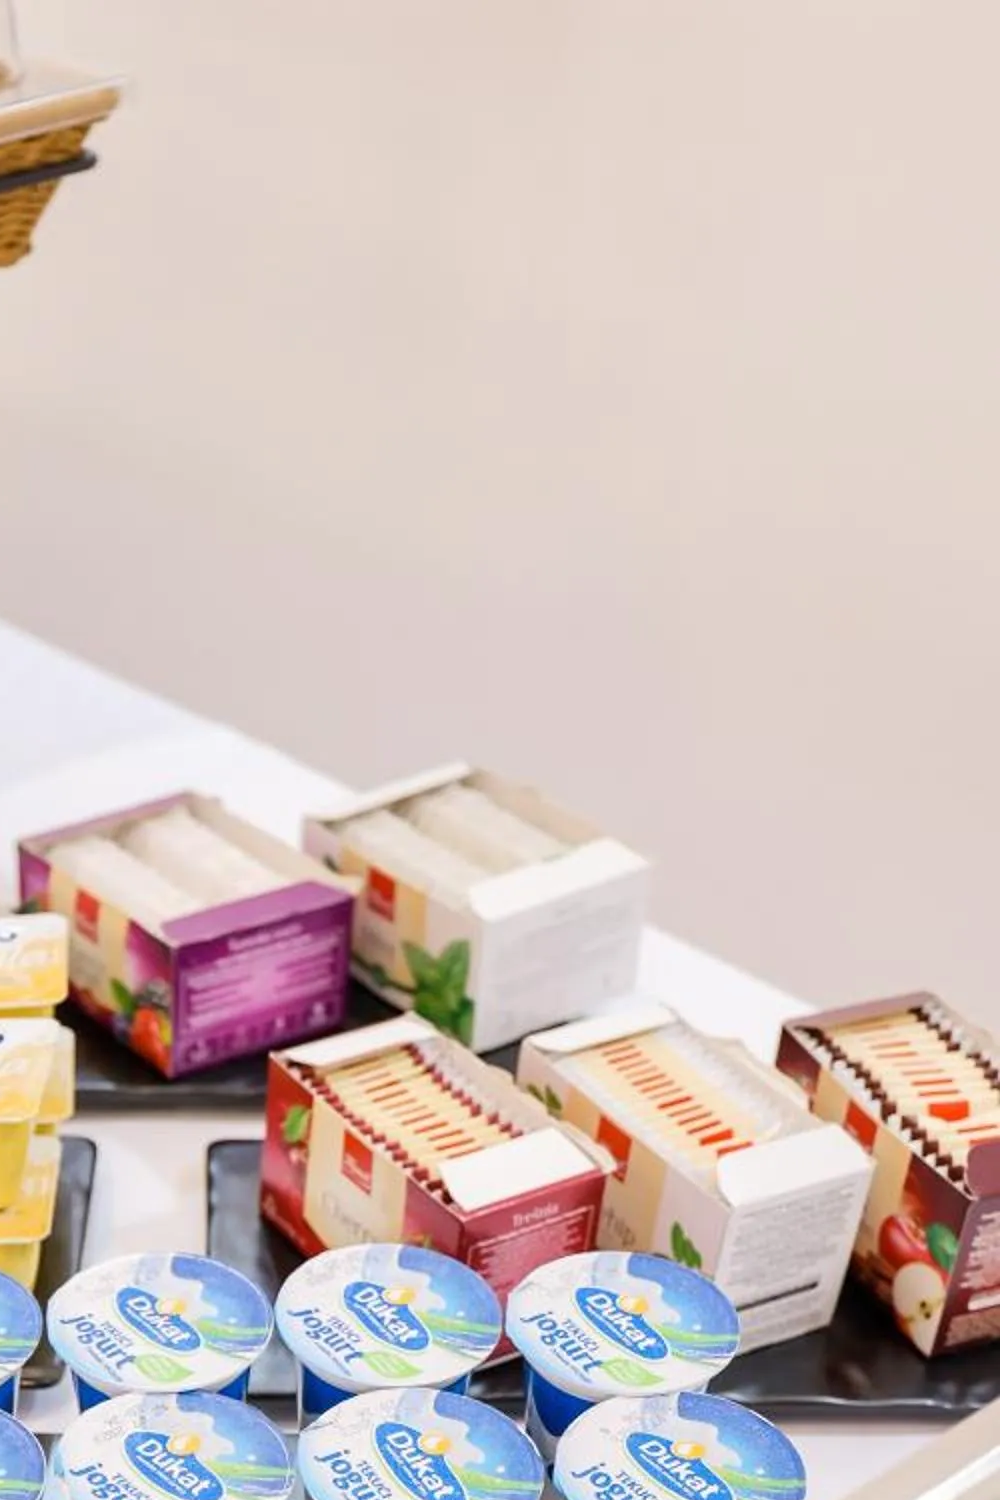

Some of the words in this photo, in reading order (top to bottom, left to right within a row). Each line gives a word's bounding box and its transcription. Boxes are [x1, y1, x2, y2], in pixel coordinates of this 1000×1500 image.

[60, 1313, 136, 1369] jogurt
[127, 1295, 192, 1345] Dukat
[287, 1307, 366, 1364] jogurt
[353, 1287, 419, 1343] Dukat
[520, 1311, 603, 1372] jogurt
[586, 1293, 658, 1350] Dukat
[135, 1438, 211, 1496] Dukat
[386, 1431, 456, 1500] Dukat
[638, 1440, 720, 1500] Dukat
